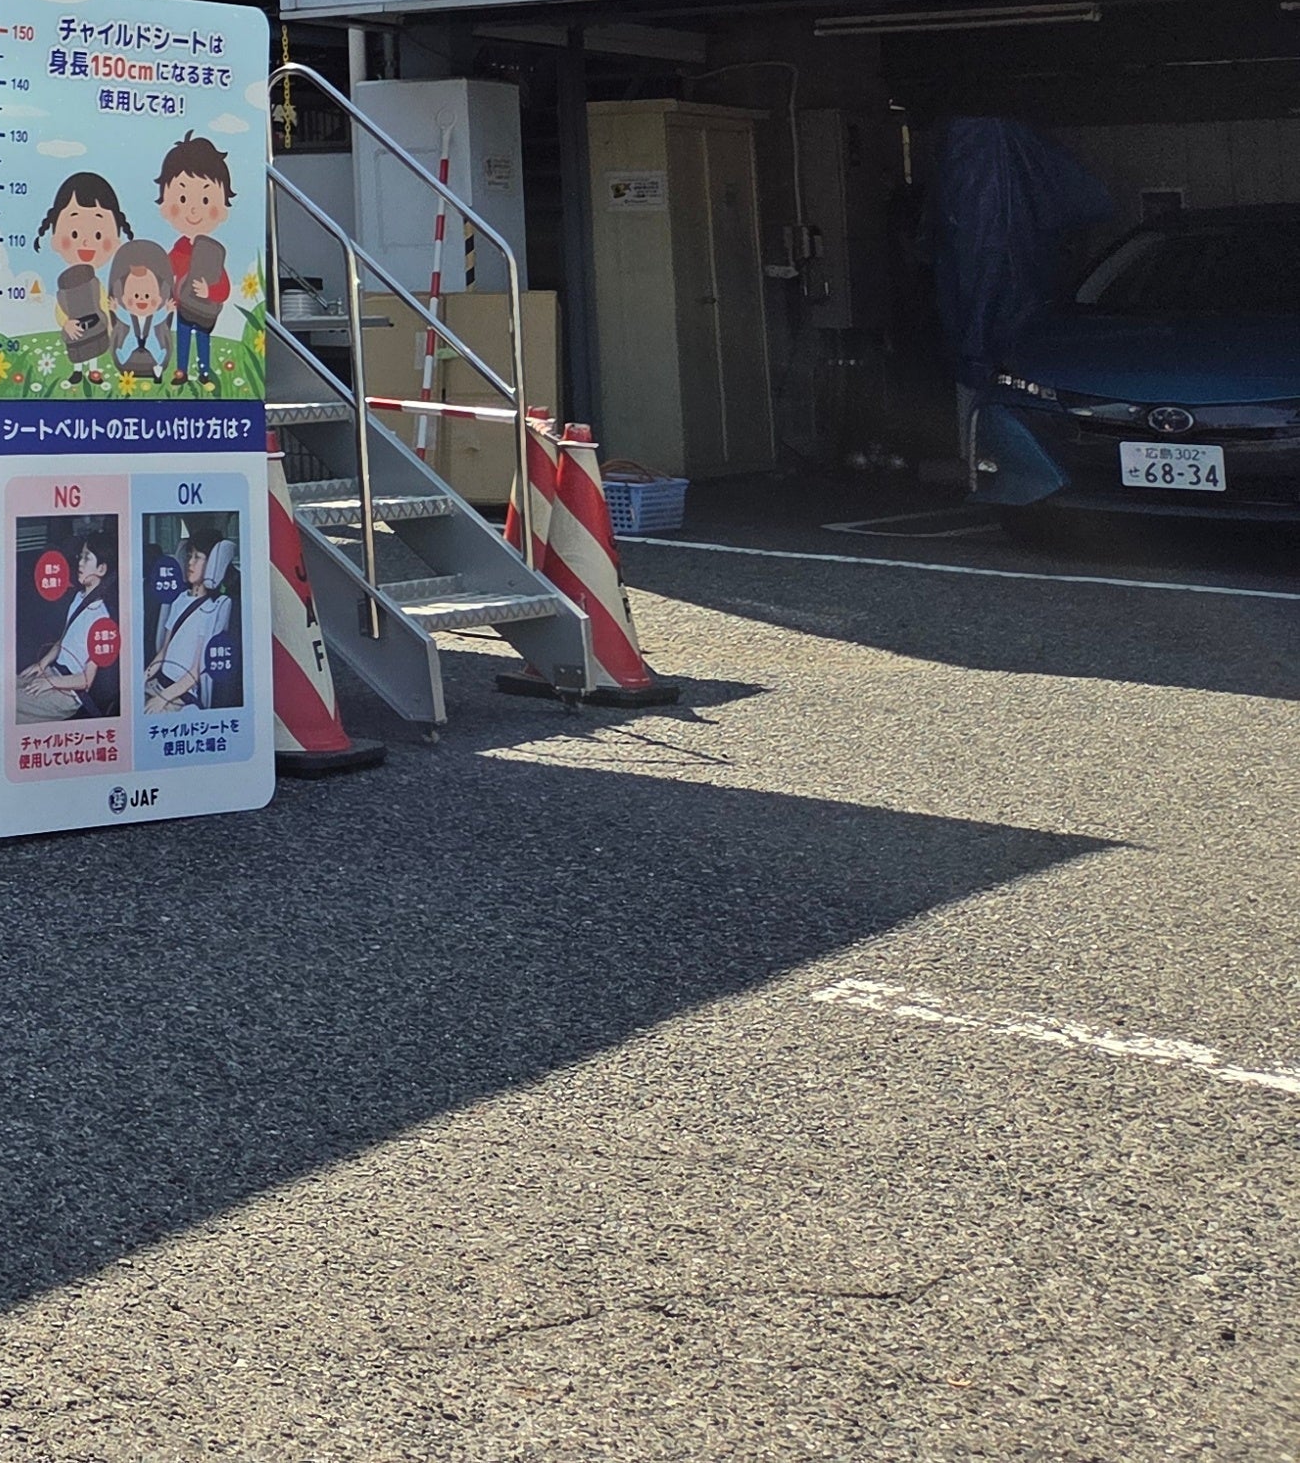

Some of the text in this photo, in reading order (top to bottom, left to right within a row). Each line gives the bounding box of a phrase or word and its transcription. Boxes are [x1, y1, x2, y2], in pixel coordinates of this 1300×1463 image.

[11, 24, 35, 42] 150
[59, 18, 224, 55] チャイルドシートは
[49, 47, 232, 87] 身長150cmになるまで
[10, 78, 30, 92] 140
[98, 89, 185, 115] 使用してね！
[9, 129, 29, 144] 130
[8, 181, 28, 196] 120
[8, 234, 26, 248] 110
[7, 285, 26, 300] 100
[6, 338, 20, 353] 90
[2, 417, 252, 441] シートベルトの正しい付け方は？
[1144, 447, 1200, 462] 広島 302
[1128, 462, 1220, 488] せ 68-34
[54, 482, 204, 509] NG OK
[20, 728, 117, 752] チャイルドシートを
[148, 718, 240, 741] チャイルドシートを
[162, 736, 228, 757] 使用した場合
[18, 746, 119, 770] 使用していない場合
[130, 788, 160, 809] JAF
